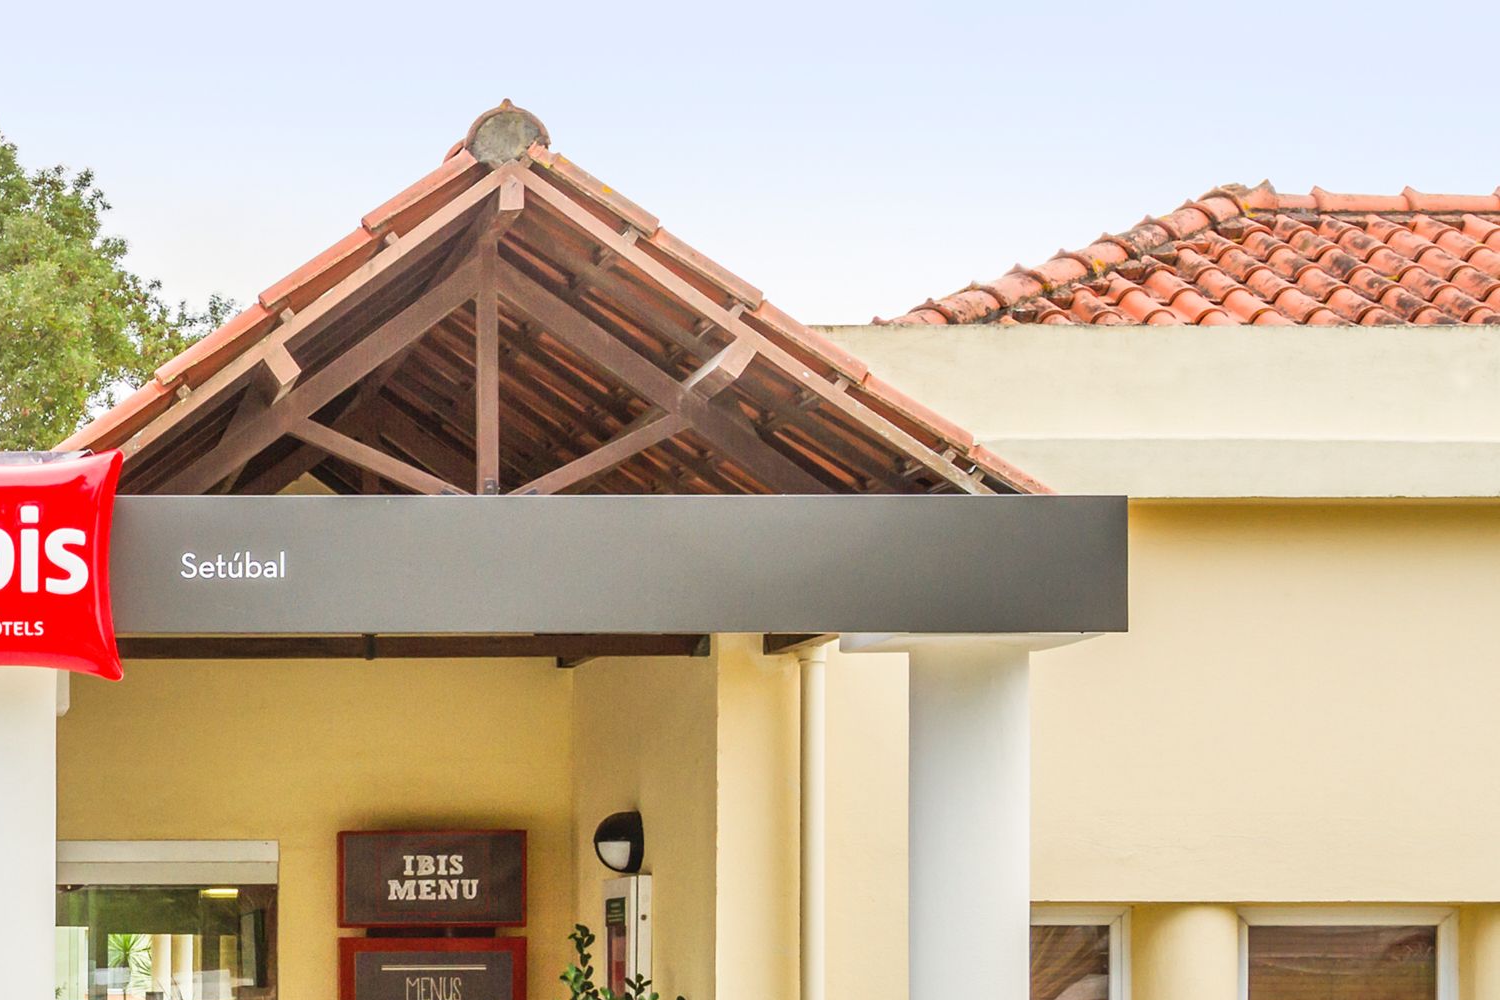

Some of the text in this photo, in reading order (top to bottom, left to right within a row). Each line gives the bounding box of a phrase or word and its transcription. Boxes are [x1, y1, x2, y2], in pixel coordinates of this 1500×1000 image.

[180, 551, 285, 579] Setúbal
[403, 855, 464, 876] IBIS
[387, 879, 479, 900] MENU
